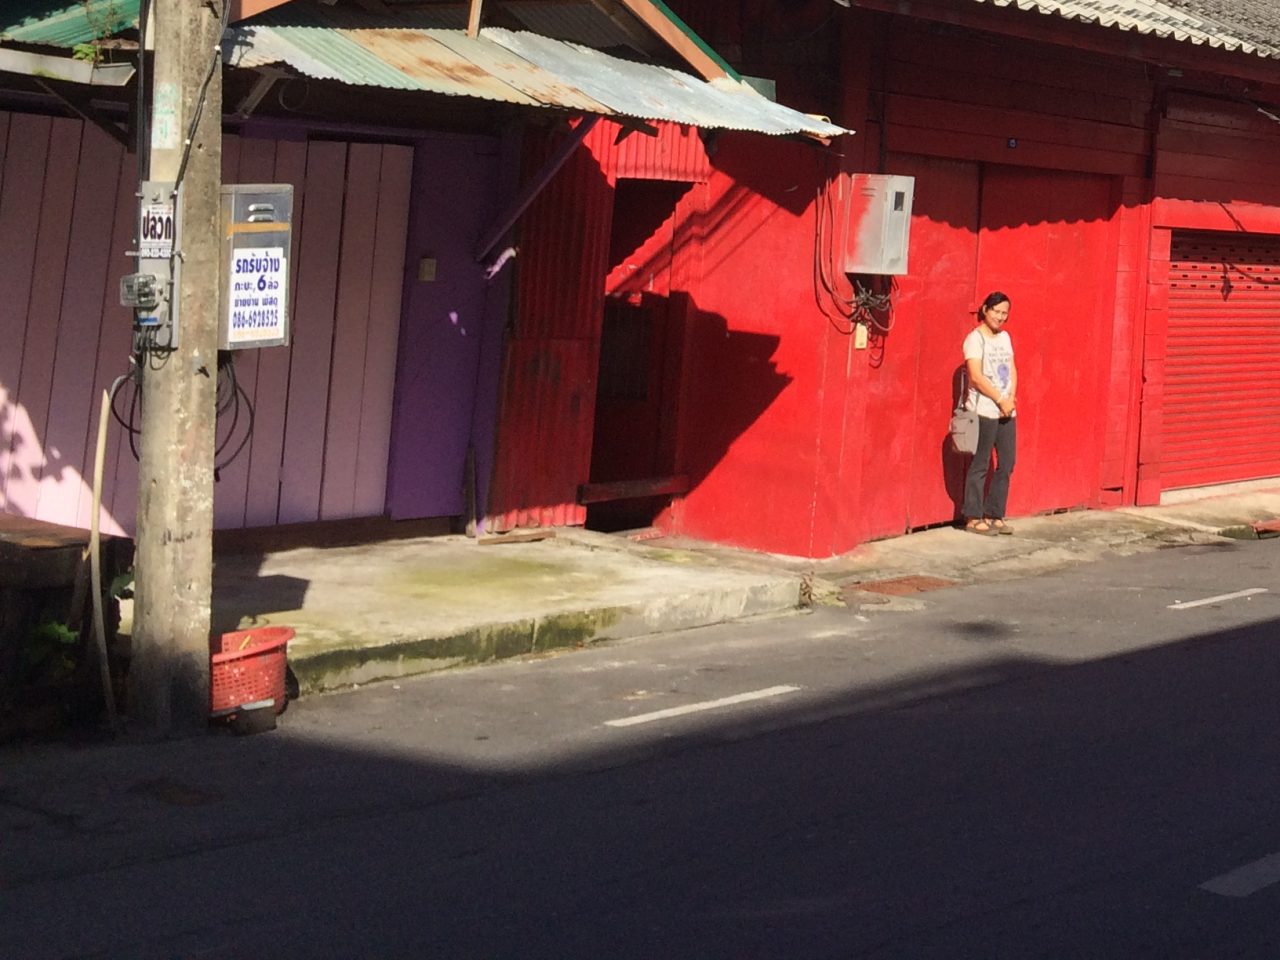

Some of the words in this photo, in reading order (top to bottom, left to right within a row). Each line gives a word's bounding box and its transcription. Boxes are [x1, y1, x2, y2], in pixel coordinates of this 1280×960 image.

[142, 209, 172, 240] ปลวก
[235, 251, 280, 274] รถรับจ้าง
[257, 274, 267, 291] 6
